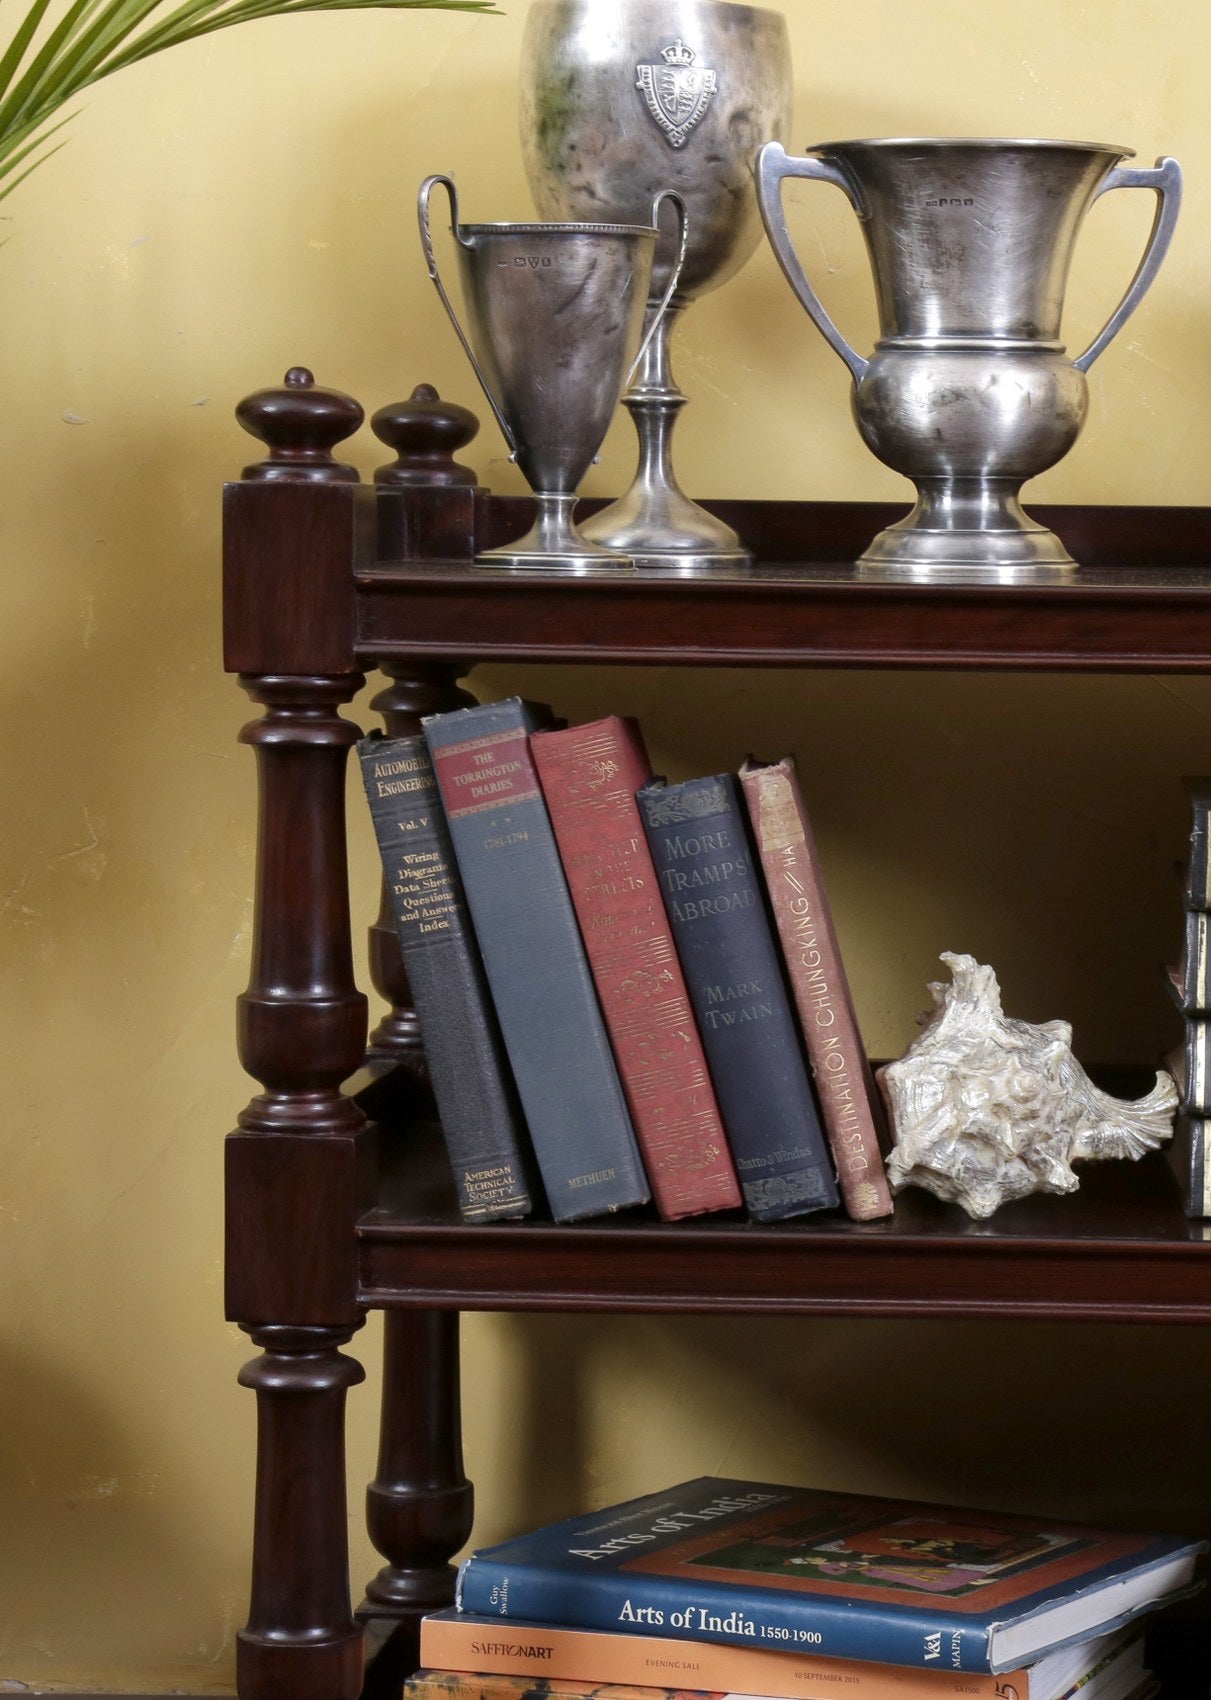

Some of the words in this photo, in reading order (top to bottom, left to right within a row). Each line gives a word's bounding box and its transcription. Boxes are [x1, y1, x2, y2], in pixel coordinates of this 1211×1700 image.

[473, 752, 495, 765] THE
[453, 760, 523, 787] TORRINGTON
[471, 778, 513, 798] DIARIES
[398, 820, 420, 832] Vol.
[420, 817, 429, 828] V
[664, 830, 731, 862] MORE
[782, 843, 798, 866] HA
[403, 853, 440, 866] Wiring
[394, 882, 421, 895] Data
[400, 910, 420, 922] and
[671, 889, 755, 923] ABROAD
[419, 920, 450, 933] Index
[790, 897, 836, 1027] CHUNGKING
[706, 980, 763, 1004] MARK
[705, 1002, 773, 1030] TWAIN
[826, 1036, 869, 1172] DESTINATION
[737, 1157, 767, 1170] Chatto
[775, 1146, 812, 1163] Windus
[463, 1176, 516, 1195] TECHNICAL
[464, 1165, 513, 1185] AMERICAN
[567, 1168, 617, 1190] METHUEN
[468, 1184, 514, 1203] SOCIETY
[568, 1530, 657, 1561] Arts
[651, 1513, 694, 1535] of
[677, 1491, 778, 1526] India
[489, 1584, 501, 1605] Guy
[499, 1576, 509, 1615] Swallow
[618, 1599, 664, 1628] Arts
[670, 1607, 694, 1630] of
[698, 1608, 757, 1637] India
[760, 1625, 822, 1645] 1550-1900
[471, 1641, 554, 1660] SAFFRONART
[952, 1629, 964, 1669] MAPIN
[646, 1658, 680, 1670] EVENING
[682, 1661, 701, 1671] SALE
[794, 1671, 802, 1680] 10
[803, 1672, 843, 1684] SEPTEMBER
[844, 1674, 861, 1684] 2015
